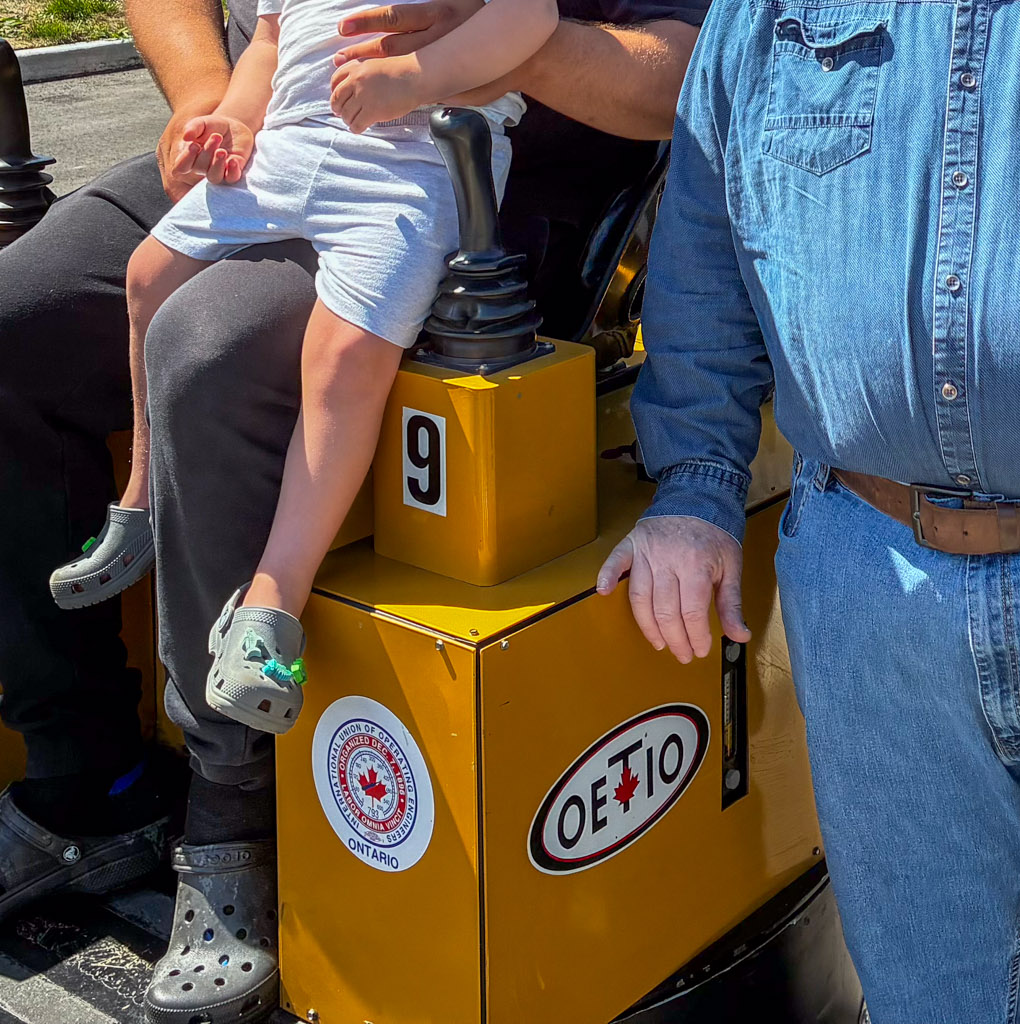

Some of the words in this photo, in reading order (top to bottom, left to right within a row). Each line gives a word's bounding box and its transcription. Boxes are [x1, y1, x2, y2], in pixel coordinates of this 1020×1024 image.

[407, 415, 441, 506] 9
[339, 724, 362, 741] UNION
[364, 724, 376, 735] OF
[340, 737, 370, 771] ORGANIZED
[378, 732, 413, 793] OPERATING
[333, 742, 360, 830] INTERNATIONAL
[342, 783, 361, 819] LABOR
[361, 816, 386, 831] OMNIA
[385, 810, 404, 831] VINCIT
[557, 733, 684, 850] OETIO
[367, 806, 380, 819] 793
[386, 798, 415, 843] ENGINEERS
[348, 837, 399, 870] ONTARIO
